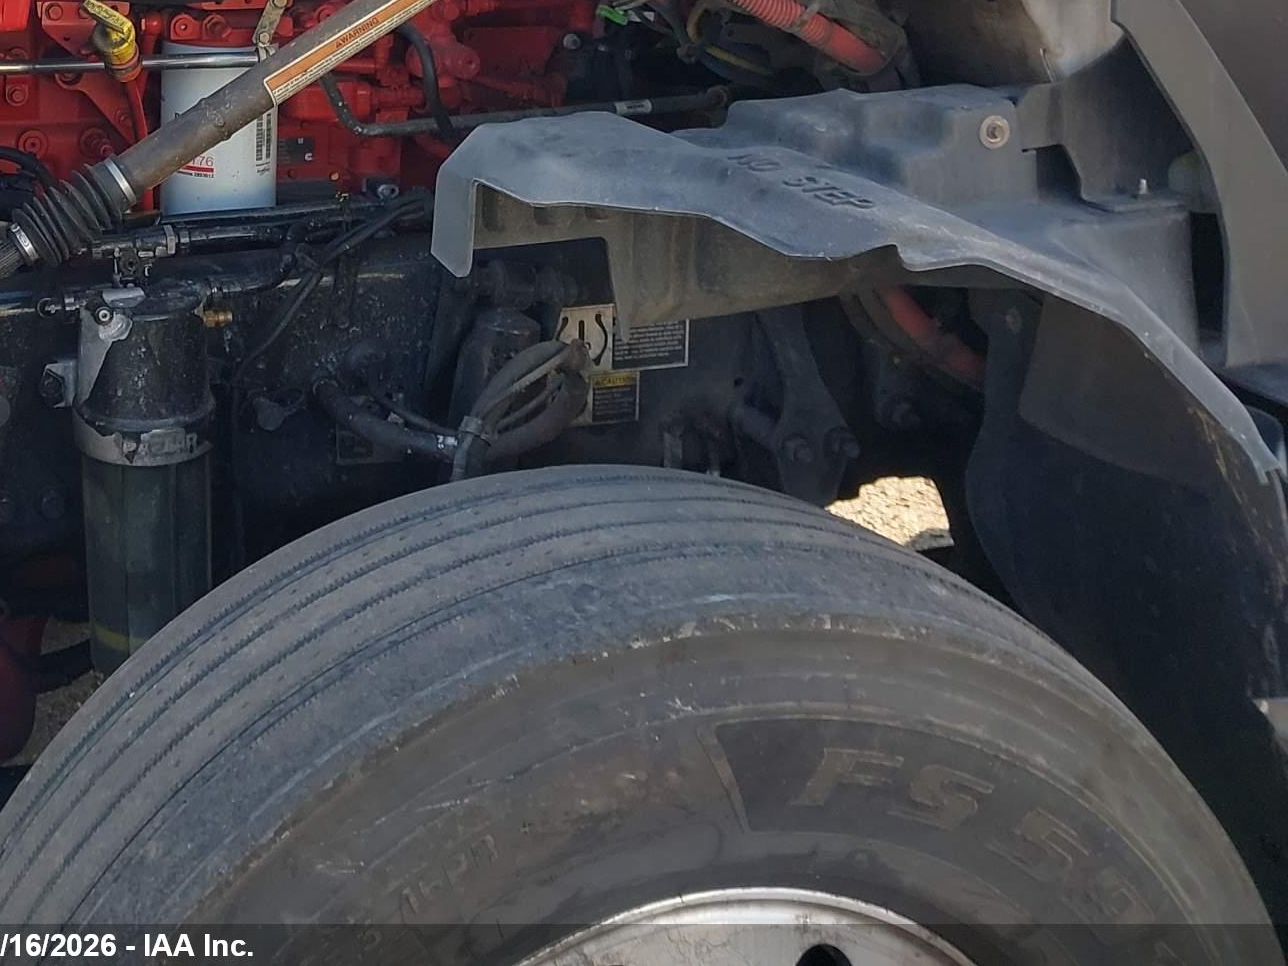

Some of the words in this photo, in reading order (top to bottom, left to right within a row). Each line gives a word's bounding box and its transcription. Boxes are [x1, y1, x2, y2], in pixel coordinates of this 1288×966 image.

[340, 17, 379, 46] WARNING
[727, 153, 782, 171] NO
[782, 176, 875, 209] STEP
